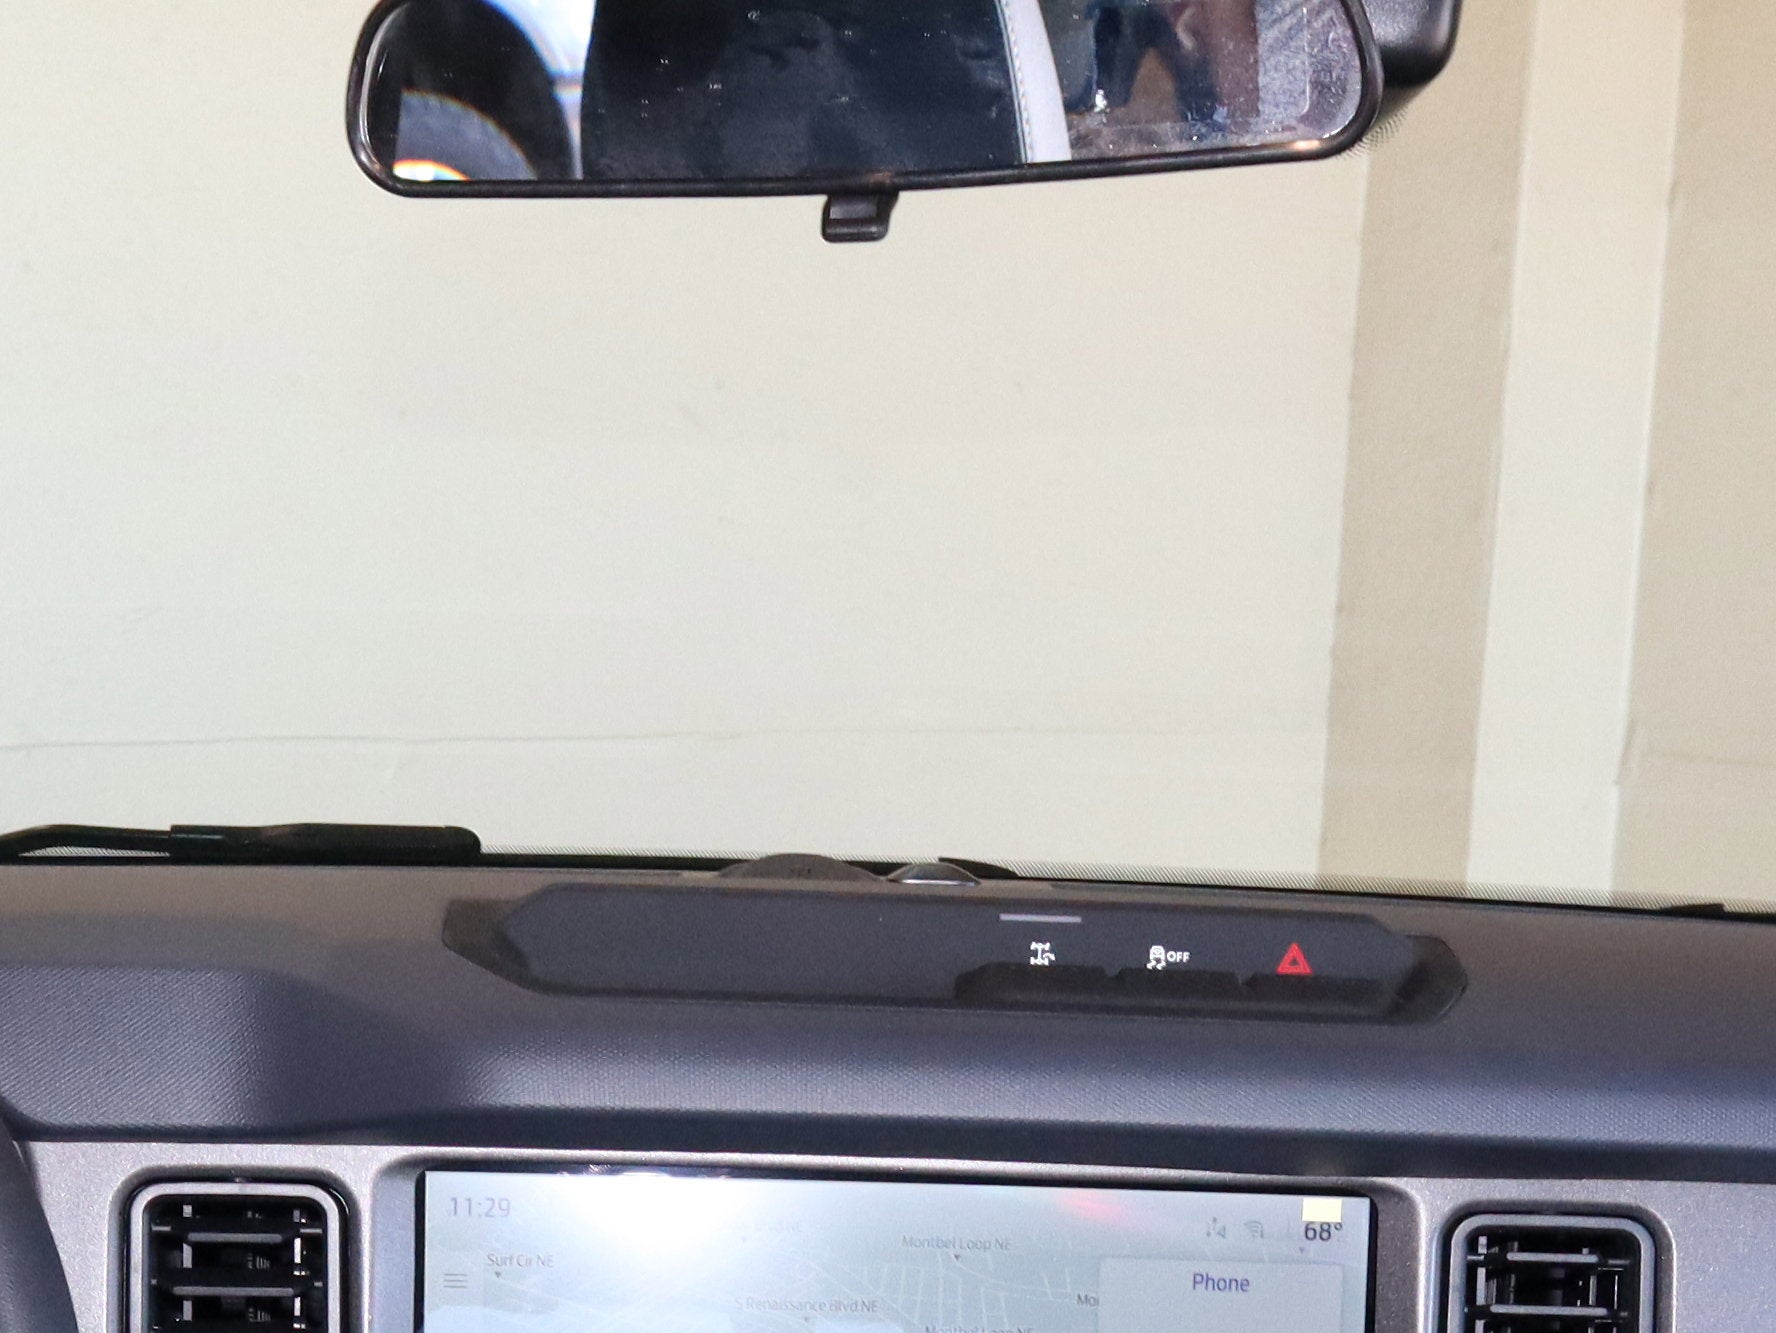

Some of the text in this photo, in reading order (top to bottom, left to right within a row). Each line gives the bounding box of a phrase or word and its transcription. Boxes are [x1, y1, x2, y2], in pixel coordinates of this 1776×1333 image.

[1166, 950, 1190, 962] OFF
[449, 1197, 511, 1218] 11:29
[1304, 1221, 1343, 1241] 68°
[959, 1237, 991, 1251] Loop
[995, 1238, 1012, 1250] NE
[487, 1254, 514, 1267] Surf
[537, 1255, 554, 1267] NE
[1192, 1273, 1250, 1293] Phone
[746, 1299, 826, 1312] Renaissance
[828, 1299, 859, 1312] Blvd
[861, 1300, 879, 1313] NE
